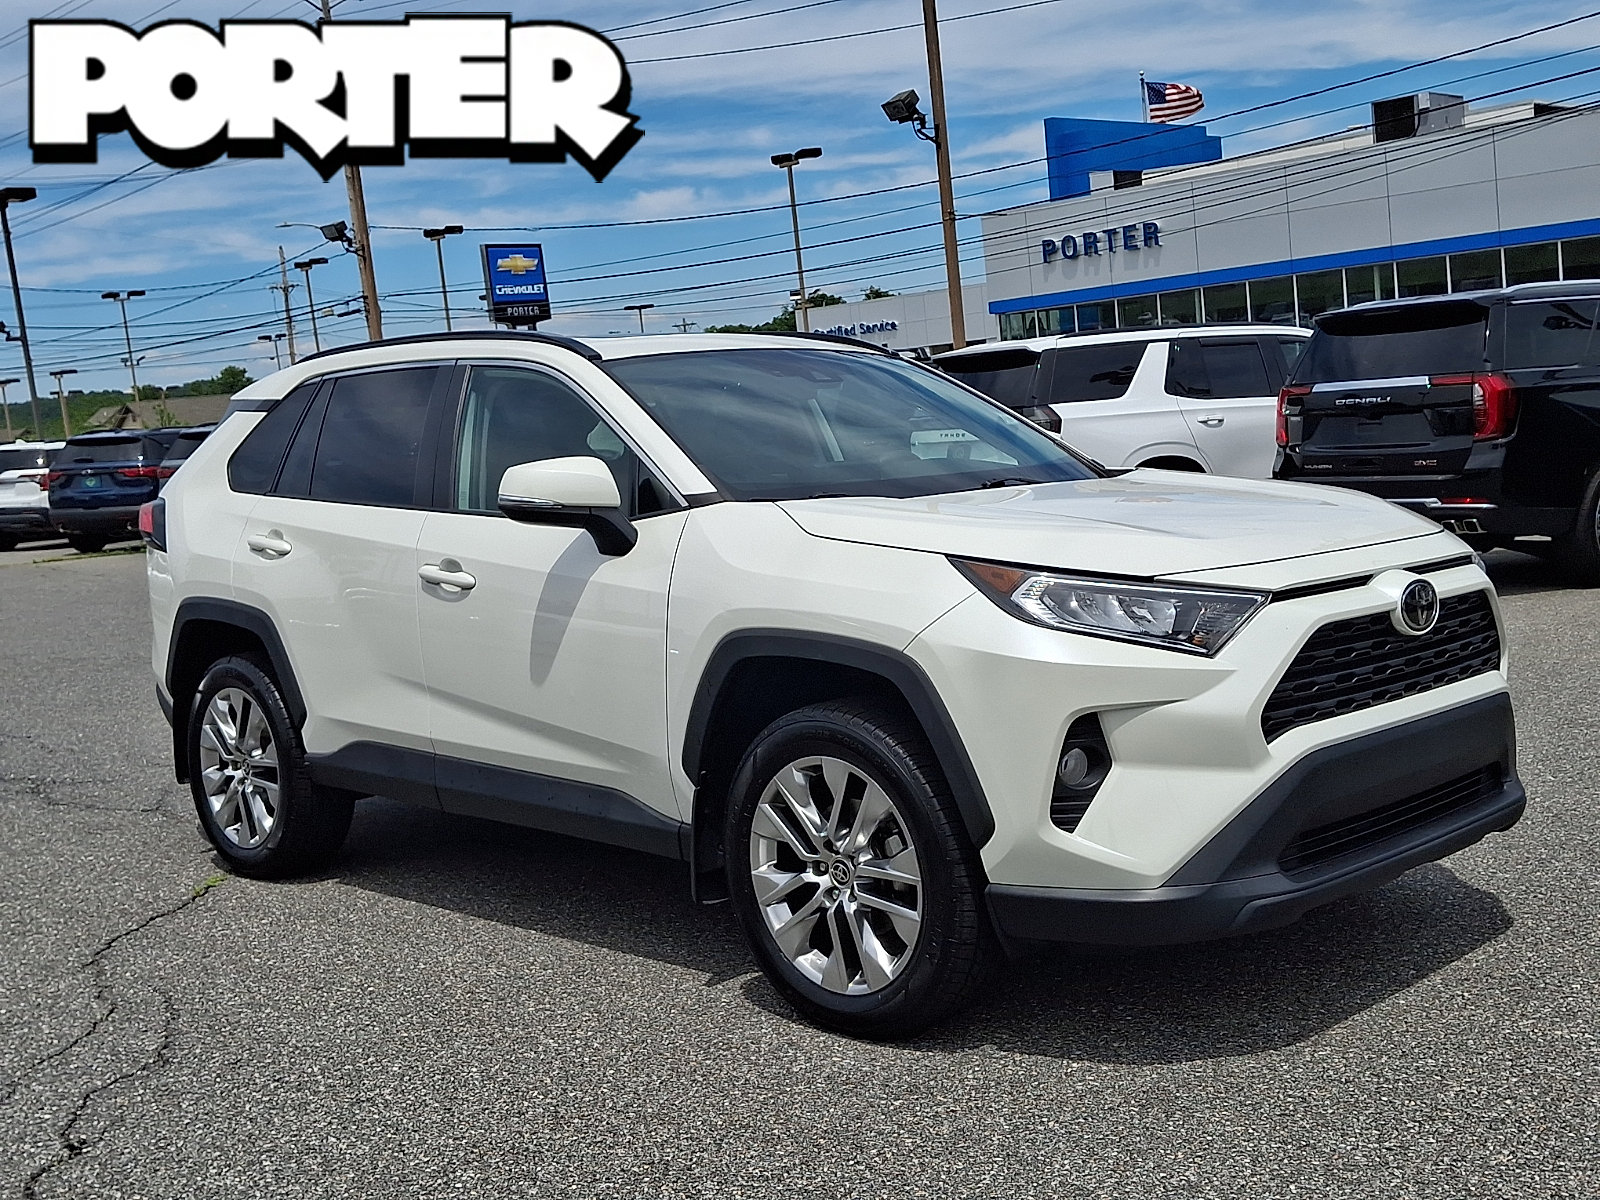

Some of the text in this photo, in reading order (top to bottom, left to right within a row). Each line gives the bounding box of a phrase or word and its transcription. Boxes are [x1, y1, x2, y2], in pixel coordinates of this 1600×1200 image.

[1041, 221, 1163, 263] PORTER
[496, 284, 544, 295] CHEVROLET
[507, 306, 540, 317] PORTER
[859, 319, 899, 335] Service
[1335, 396, 1391, 406] DENALI
